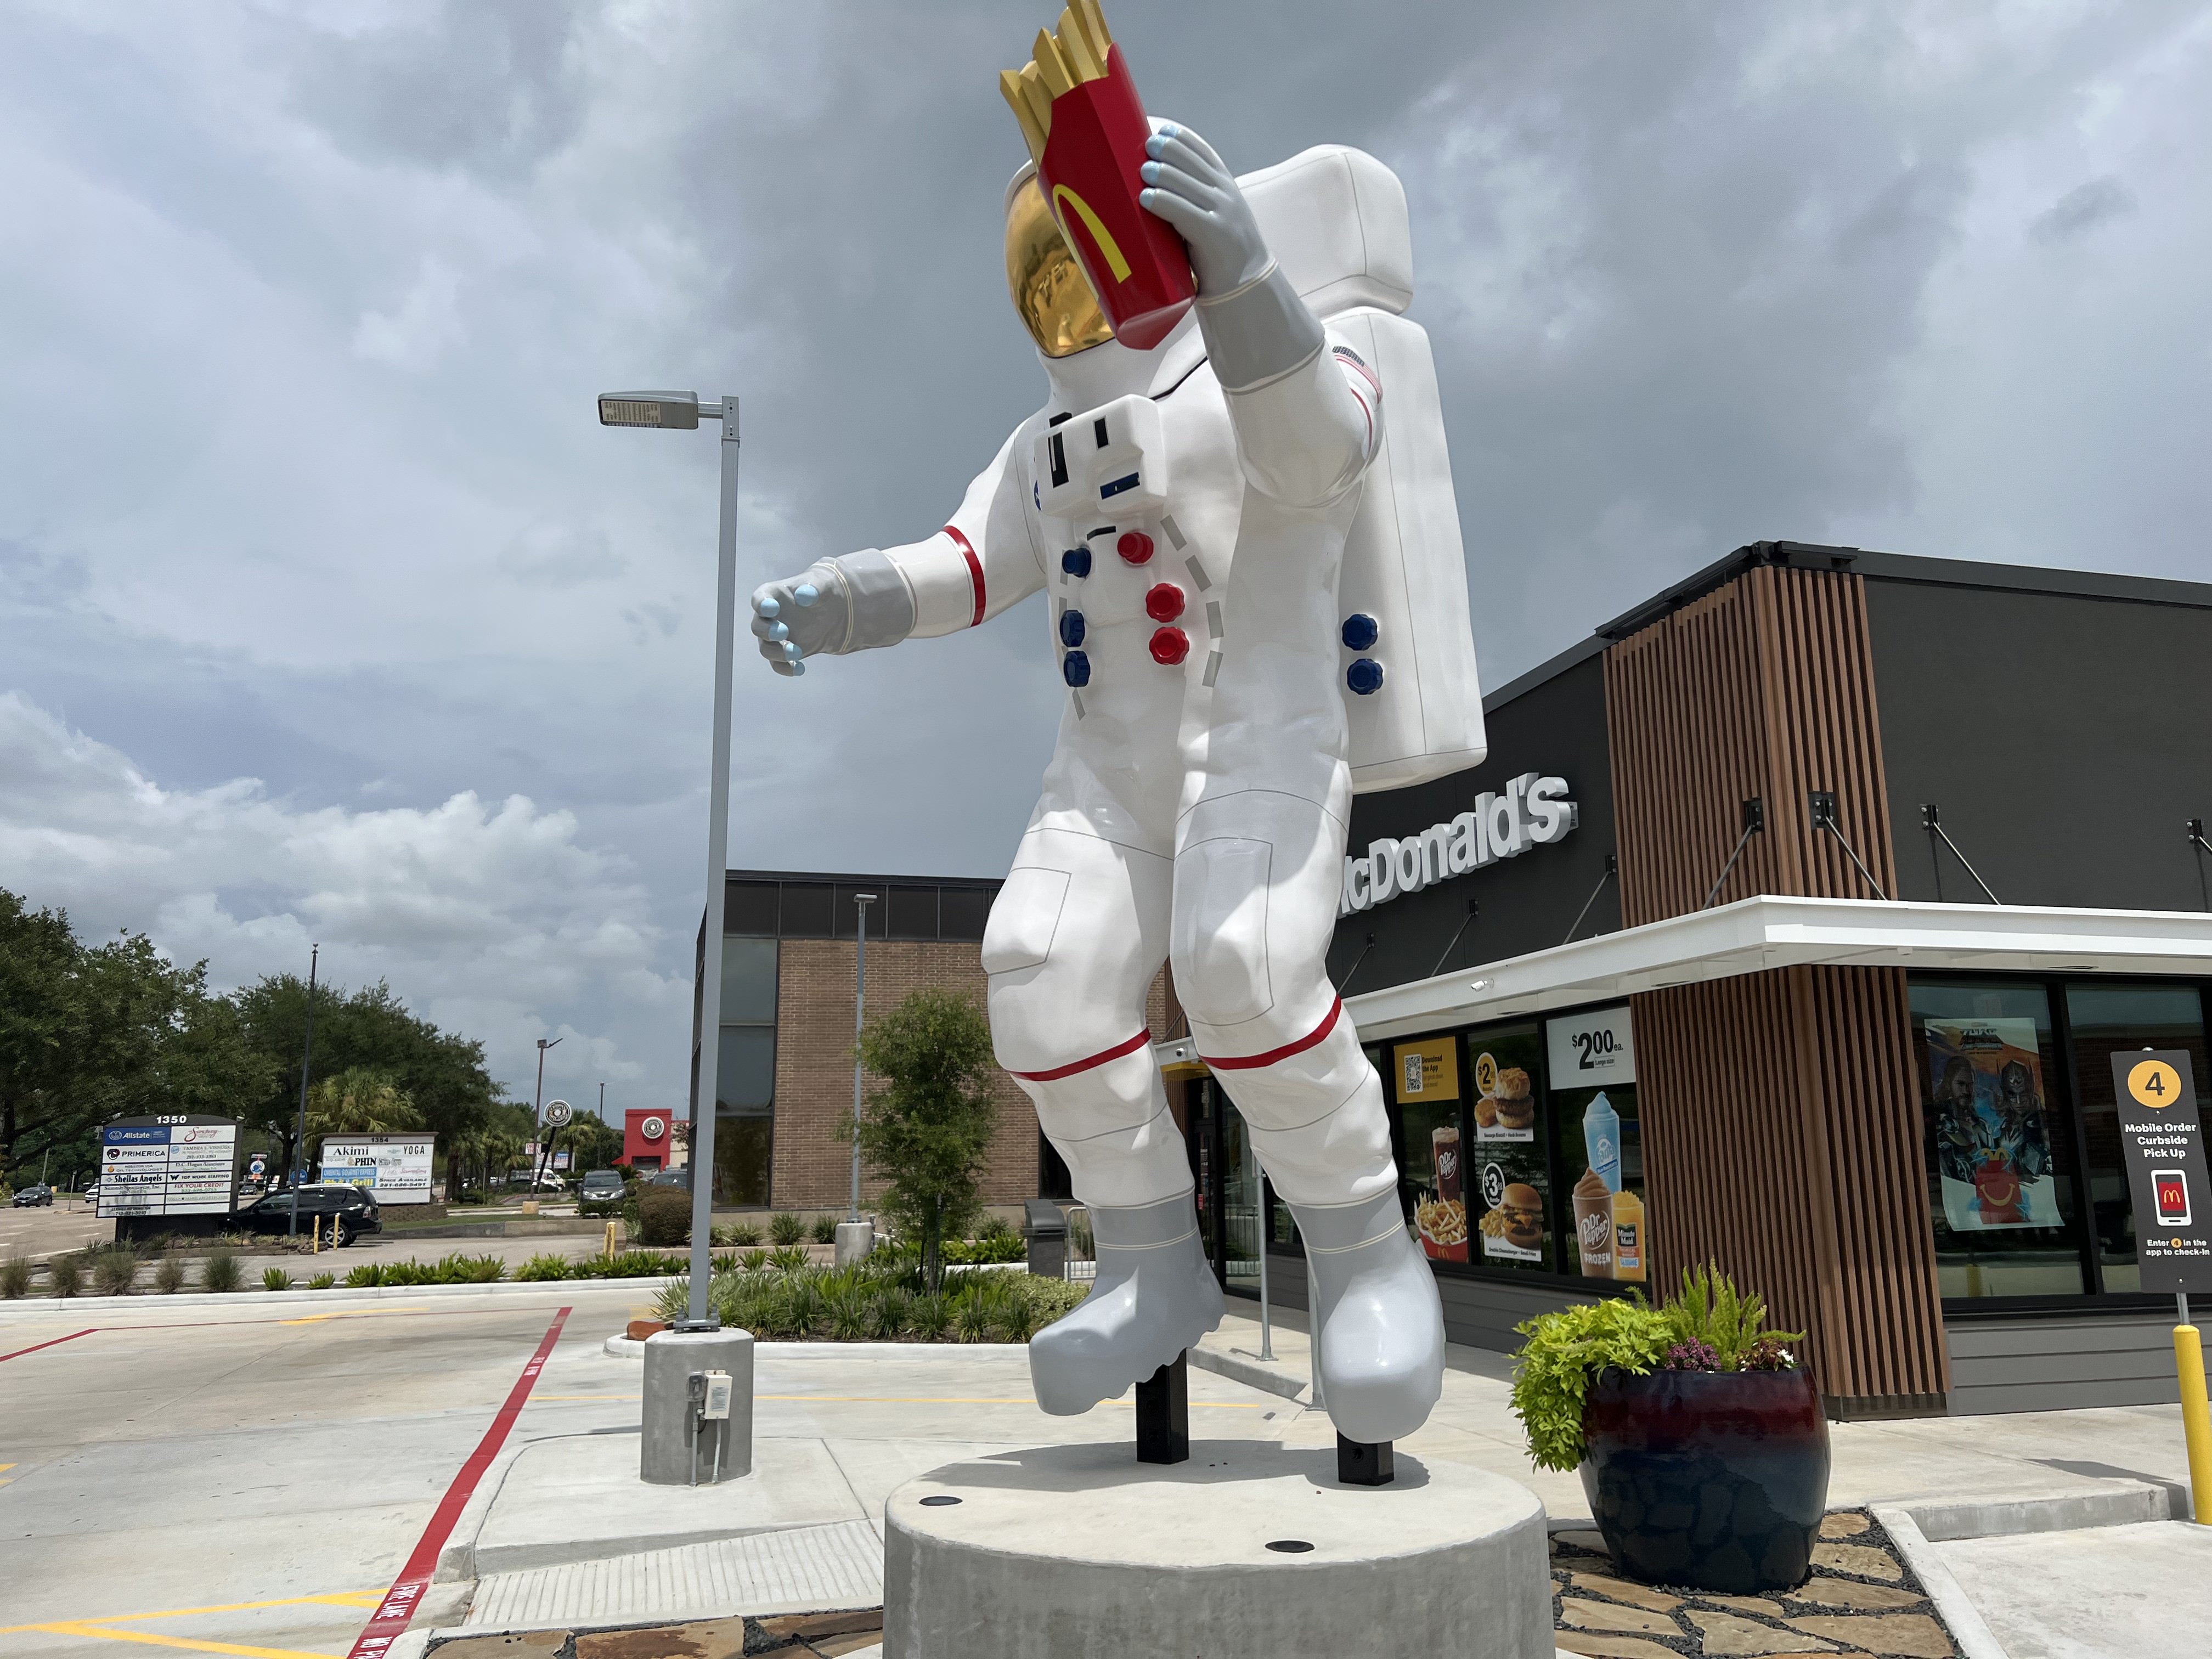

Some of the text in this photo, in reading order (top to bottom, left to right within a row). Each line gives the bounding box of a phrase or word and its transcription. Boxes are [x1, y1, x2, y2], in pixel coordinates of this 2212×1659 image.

[1422, 1054, 1442, 1064] Download
[2145, 1072, 2165, 1096] 4
[156, 1115, 187, 1124] 1350
[2125, 1122, 2196, 1132] Mobile Order
[2137, 1135, 2188, 1145] Curbside
[333, 1146, 369, 1155] Akimi
[403, 1146, 425, 1154] YOGA
[2143, 1148, 2186, 1159] Pick Up
[355, 1157, 377, 1166] PHIN
[1444, 1152, 1451, 1164] Dr
[1440, 1154, 1456, 1176] Pepper
[114, 1174, 162, 1183] Sheilas Angels
[1589, 1214, 1600, 1229] Dr
[1581, 1218, 1607, 1245] Pepper
[1584, 1252, 1611, 1265] FROZEN
[388, 1584, 420, 1601] FIRE
[375, 1600, 413, 1620] LANE
[360, 1637, 393, 1648] NO
